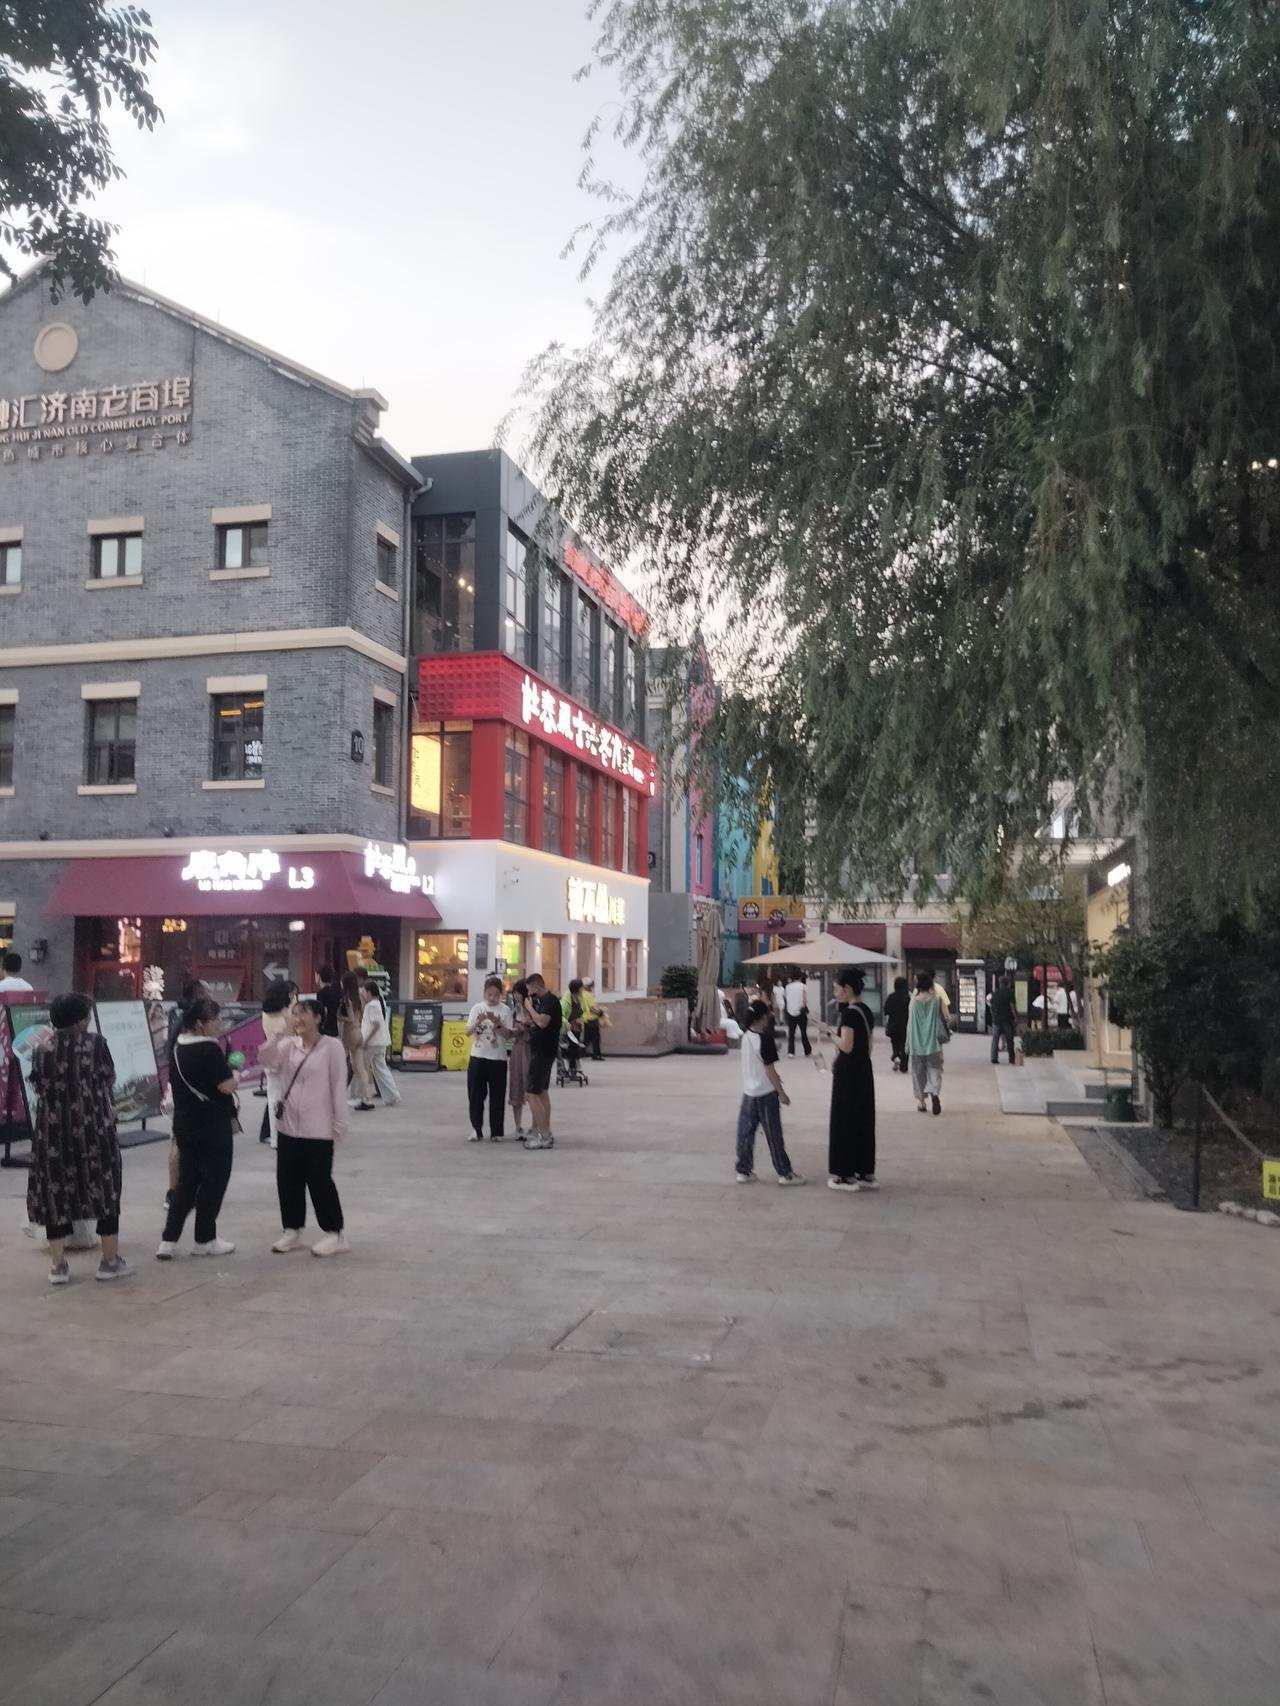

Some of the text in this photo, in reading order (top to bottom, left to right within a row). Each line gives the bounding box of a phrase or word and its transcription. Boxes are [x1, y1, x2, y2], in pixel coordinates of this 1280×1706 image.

[43, 426, 65, 438] NAN
[66, 424, 88, 435] OLD
[90, 416, 156, 432] COMMERCIAL
[161, 413, 188, 425] PORT
